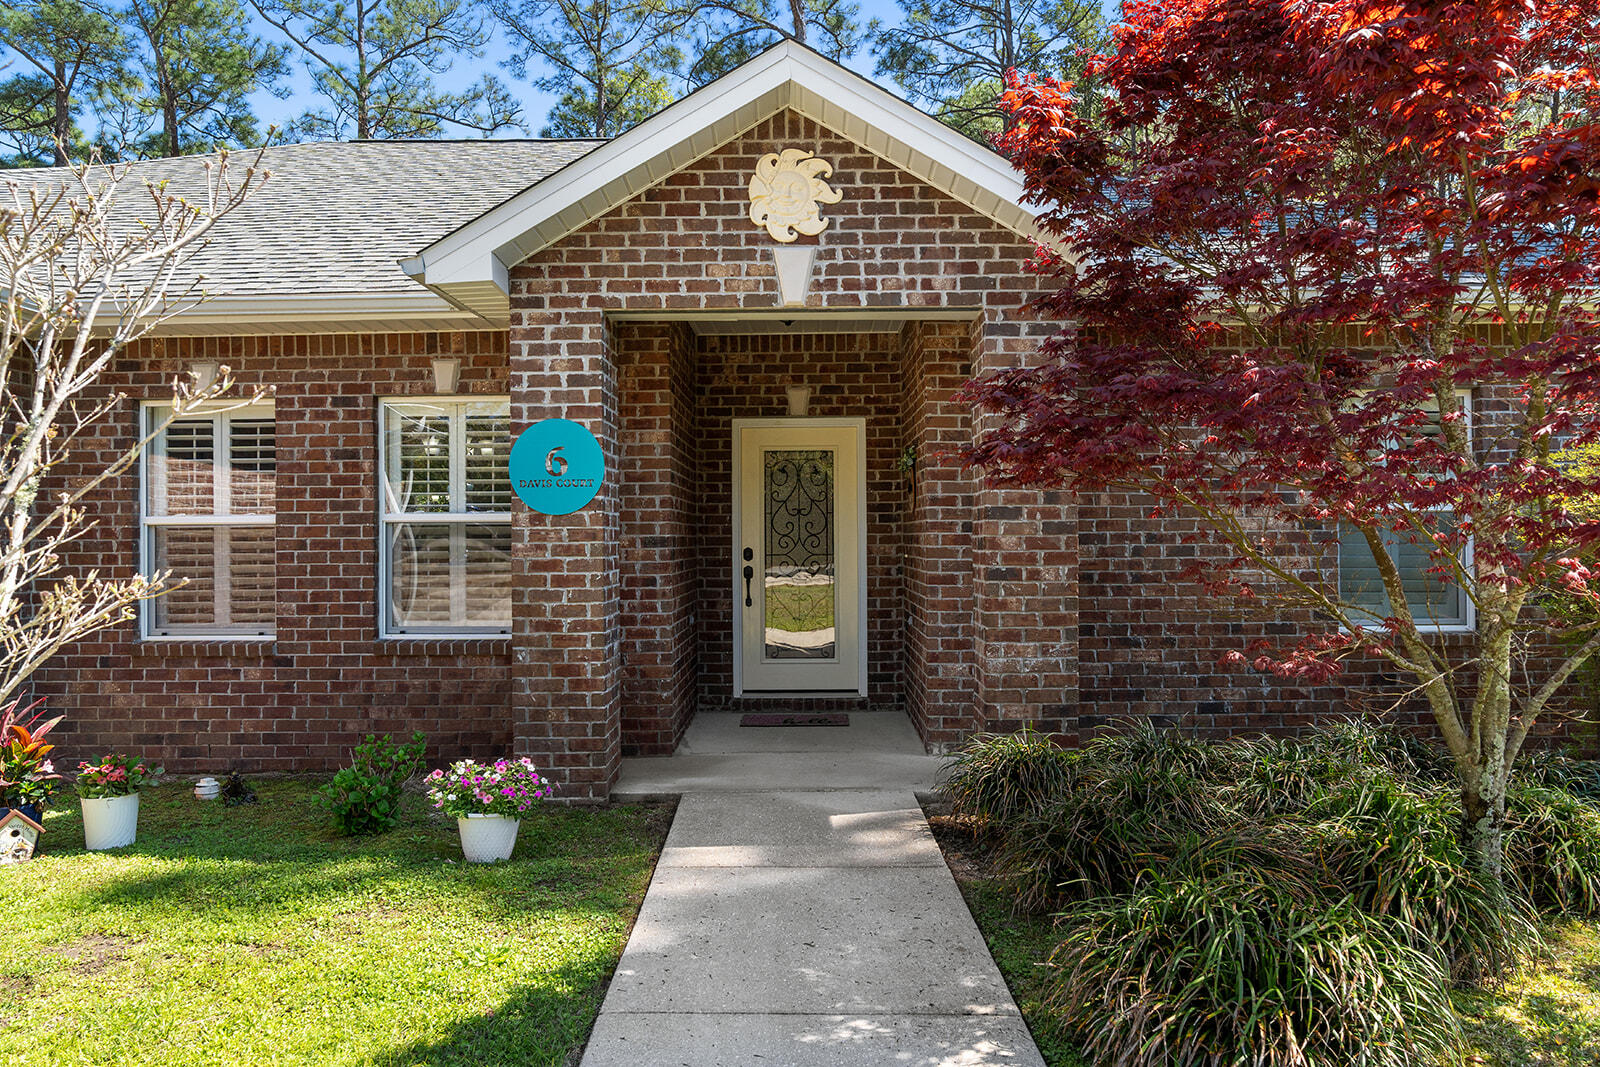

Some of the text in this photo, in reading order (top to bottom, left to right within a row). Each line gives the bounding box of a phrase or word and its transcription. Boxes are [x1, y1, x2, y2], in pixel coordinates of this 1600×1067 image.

[545, 446, 568, 477] 6
[519, 479, 594, 488] DAVIS COURT
